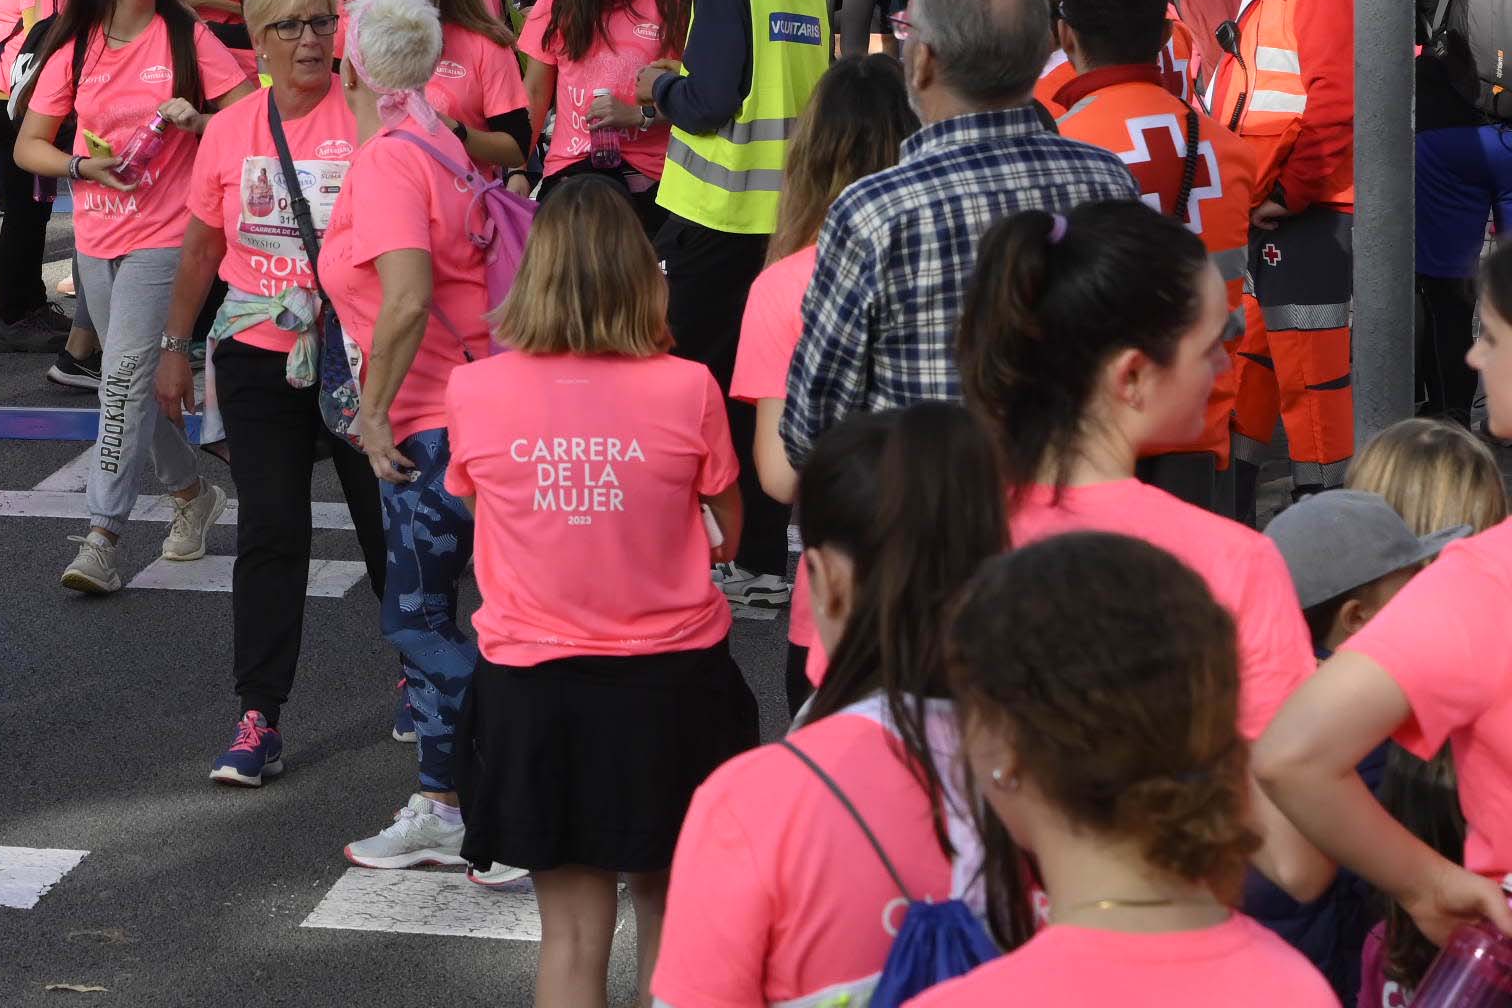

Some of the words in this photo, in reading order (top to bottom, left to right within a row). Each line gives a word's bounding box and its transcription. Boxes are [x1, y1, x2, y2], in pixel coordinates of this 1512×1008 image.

[250, 226, 282, 234] CARRERA
[116, 353, 139, 380] USA
[100, 374, 132, 474] BROOKLYN
[510, 437, 645, 462] CARRERA
[537, 463, 571, 486] DE
[584, 463, 619, 486] LA
[533, 489, 624, 512] MUJER
[568, 516, 591, 525] 2023
